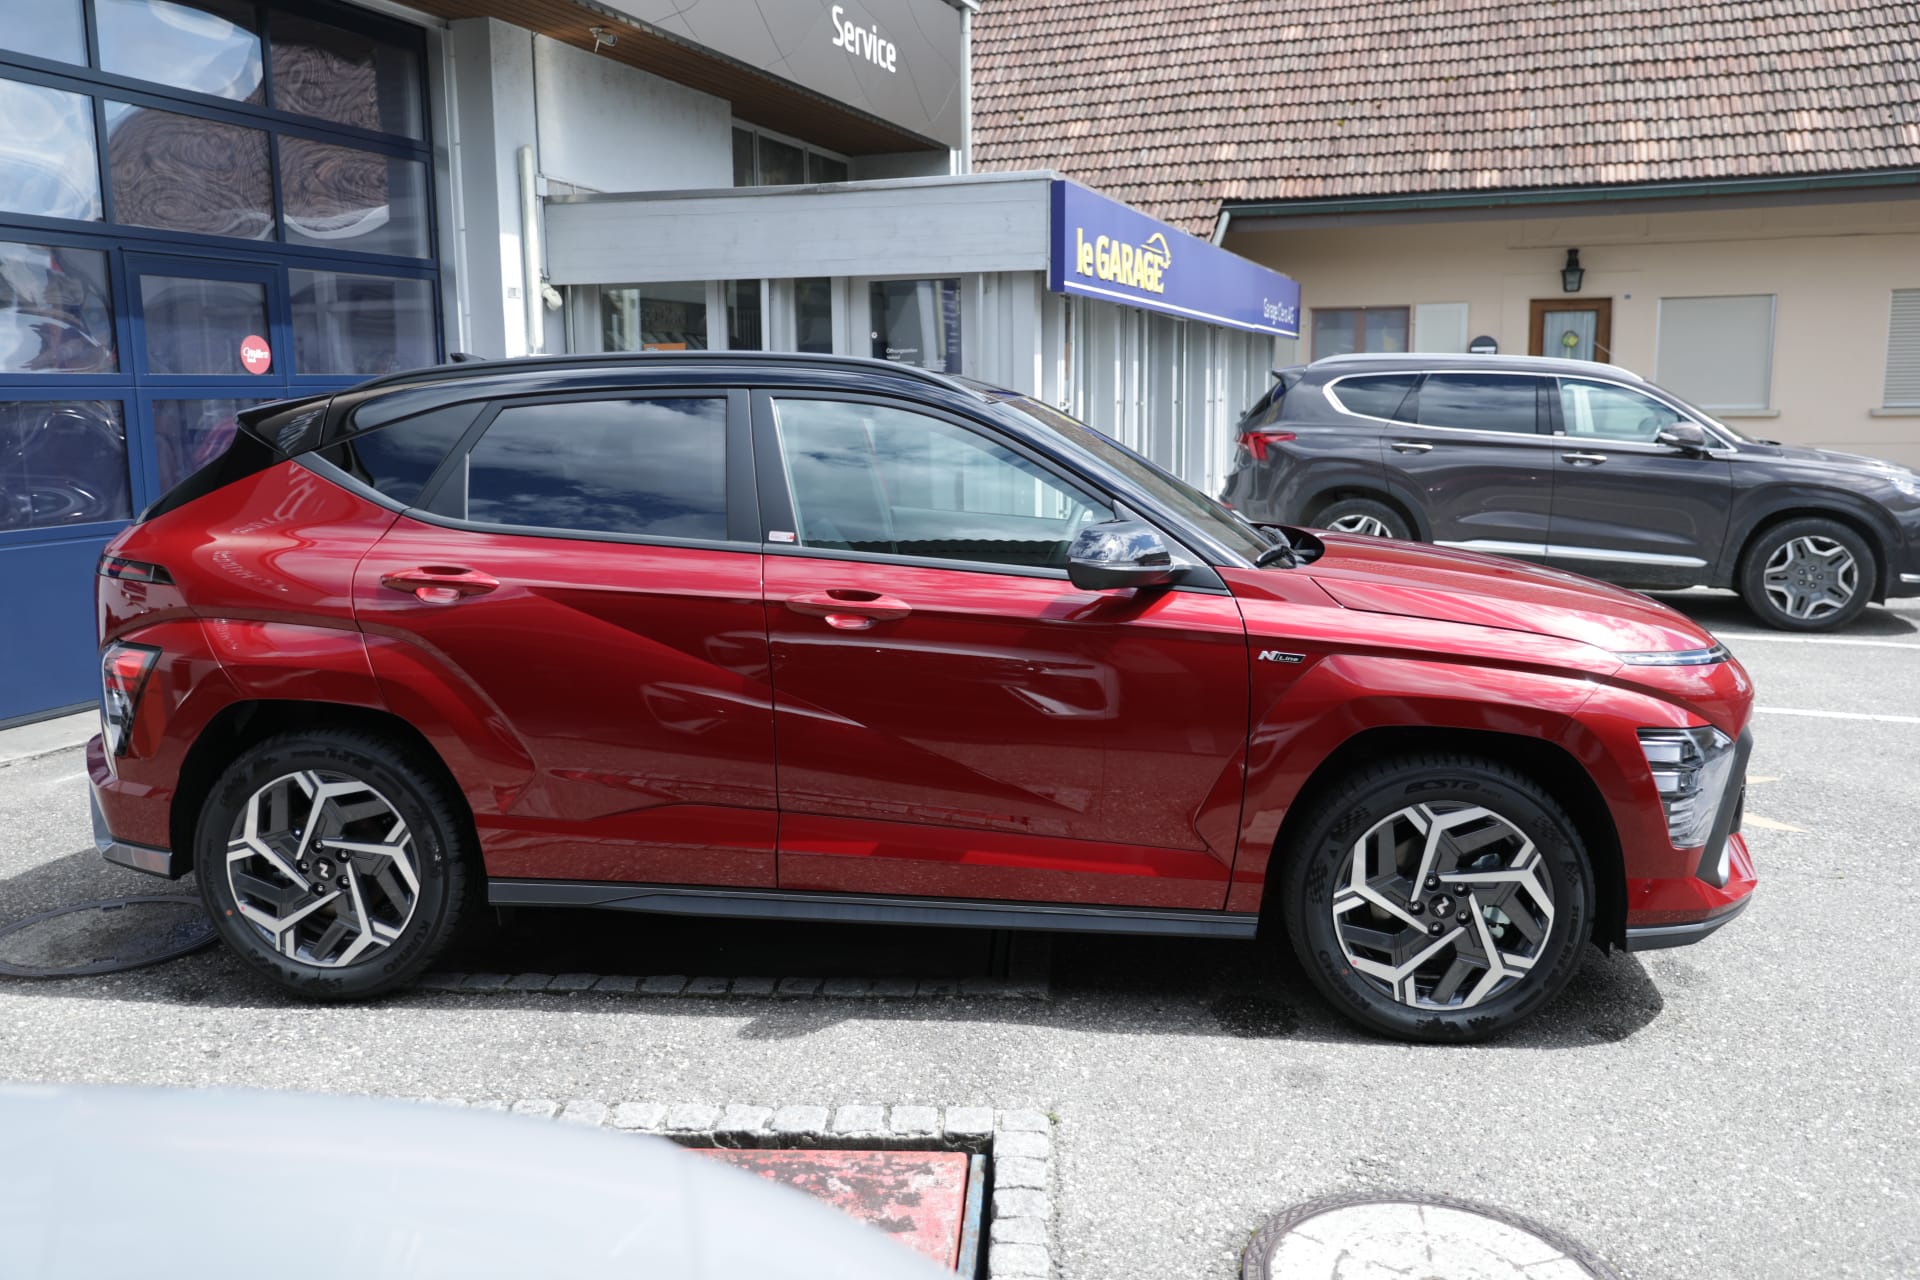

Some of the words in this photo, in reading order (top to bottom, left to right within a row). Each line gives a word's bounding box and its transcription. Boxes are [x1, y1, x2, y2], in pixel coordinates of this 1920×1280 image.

[832, 5, 896, 73] Service
[1076, 227, 1094, 277] le
[1095, 234, 1165, 295] GARAGE
[1257, 650, 1279, 661] N
